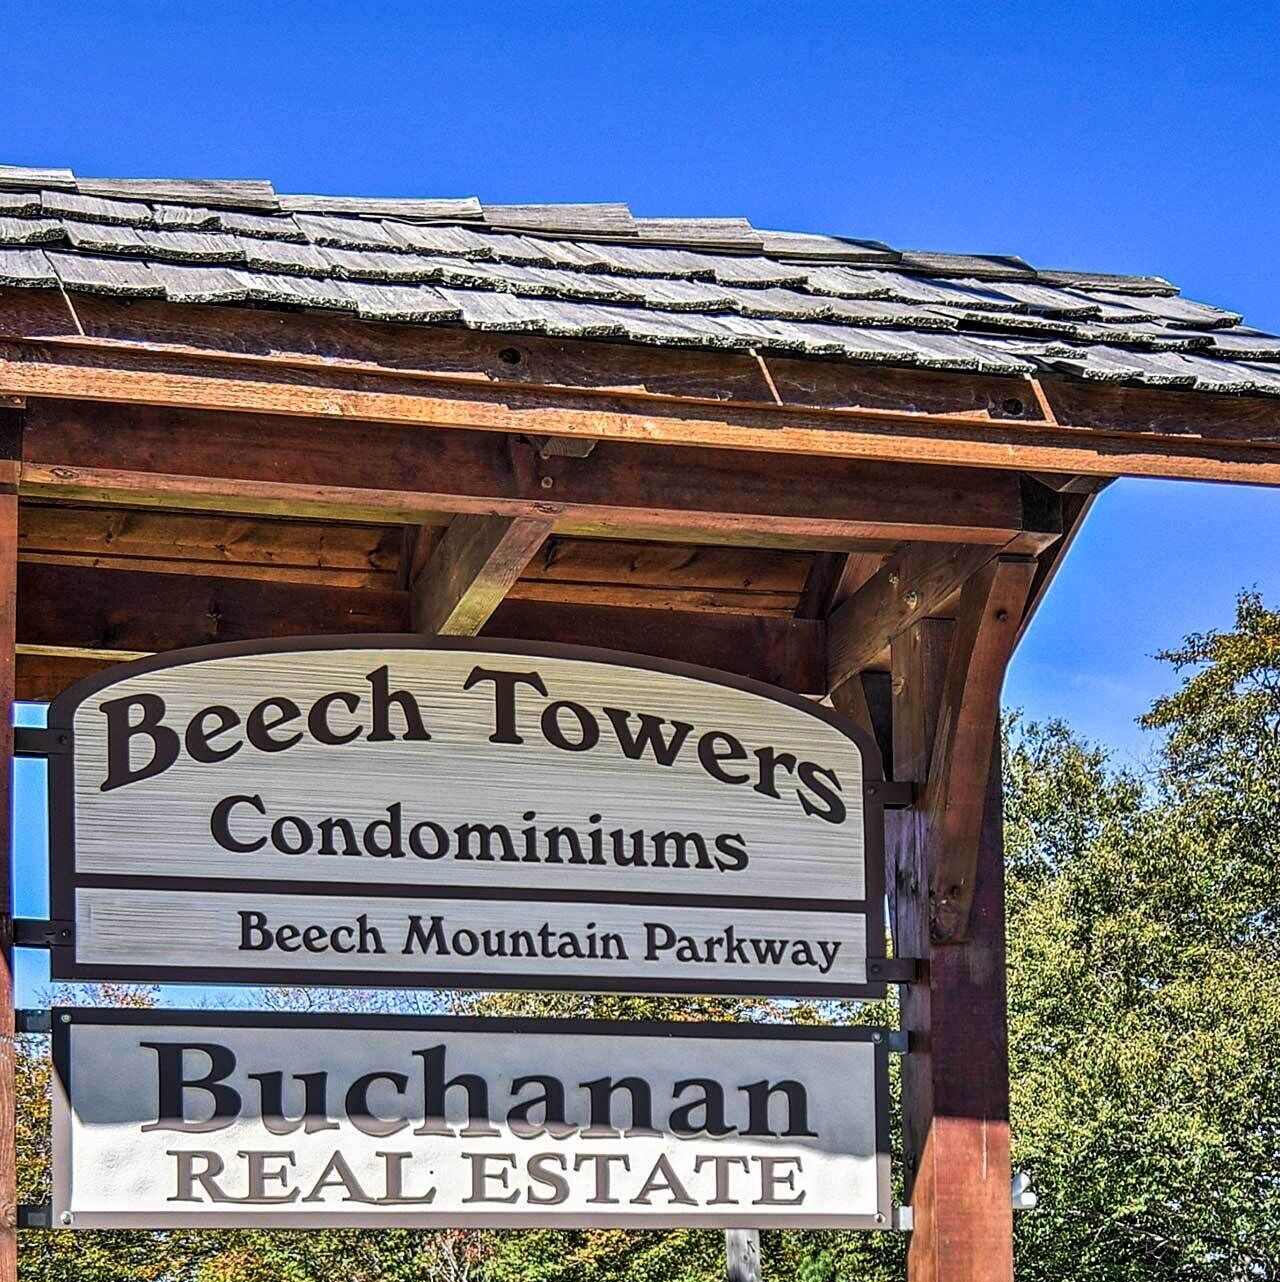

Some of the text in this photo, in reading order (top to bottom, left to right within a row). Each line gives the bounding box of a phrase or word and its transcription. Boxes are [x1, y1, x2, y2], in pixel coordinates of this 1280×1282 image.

[99, 664, 847, 825] Beech Towers
[210, 794, 750, 873] Condominiums
[237, 910, 843, 975] Beech Mountain Parkway
[139, 1040, 820, 1141] Buchanan
[166, 1149, 808, 1207] REAL ESTATE
